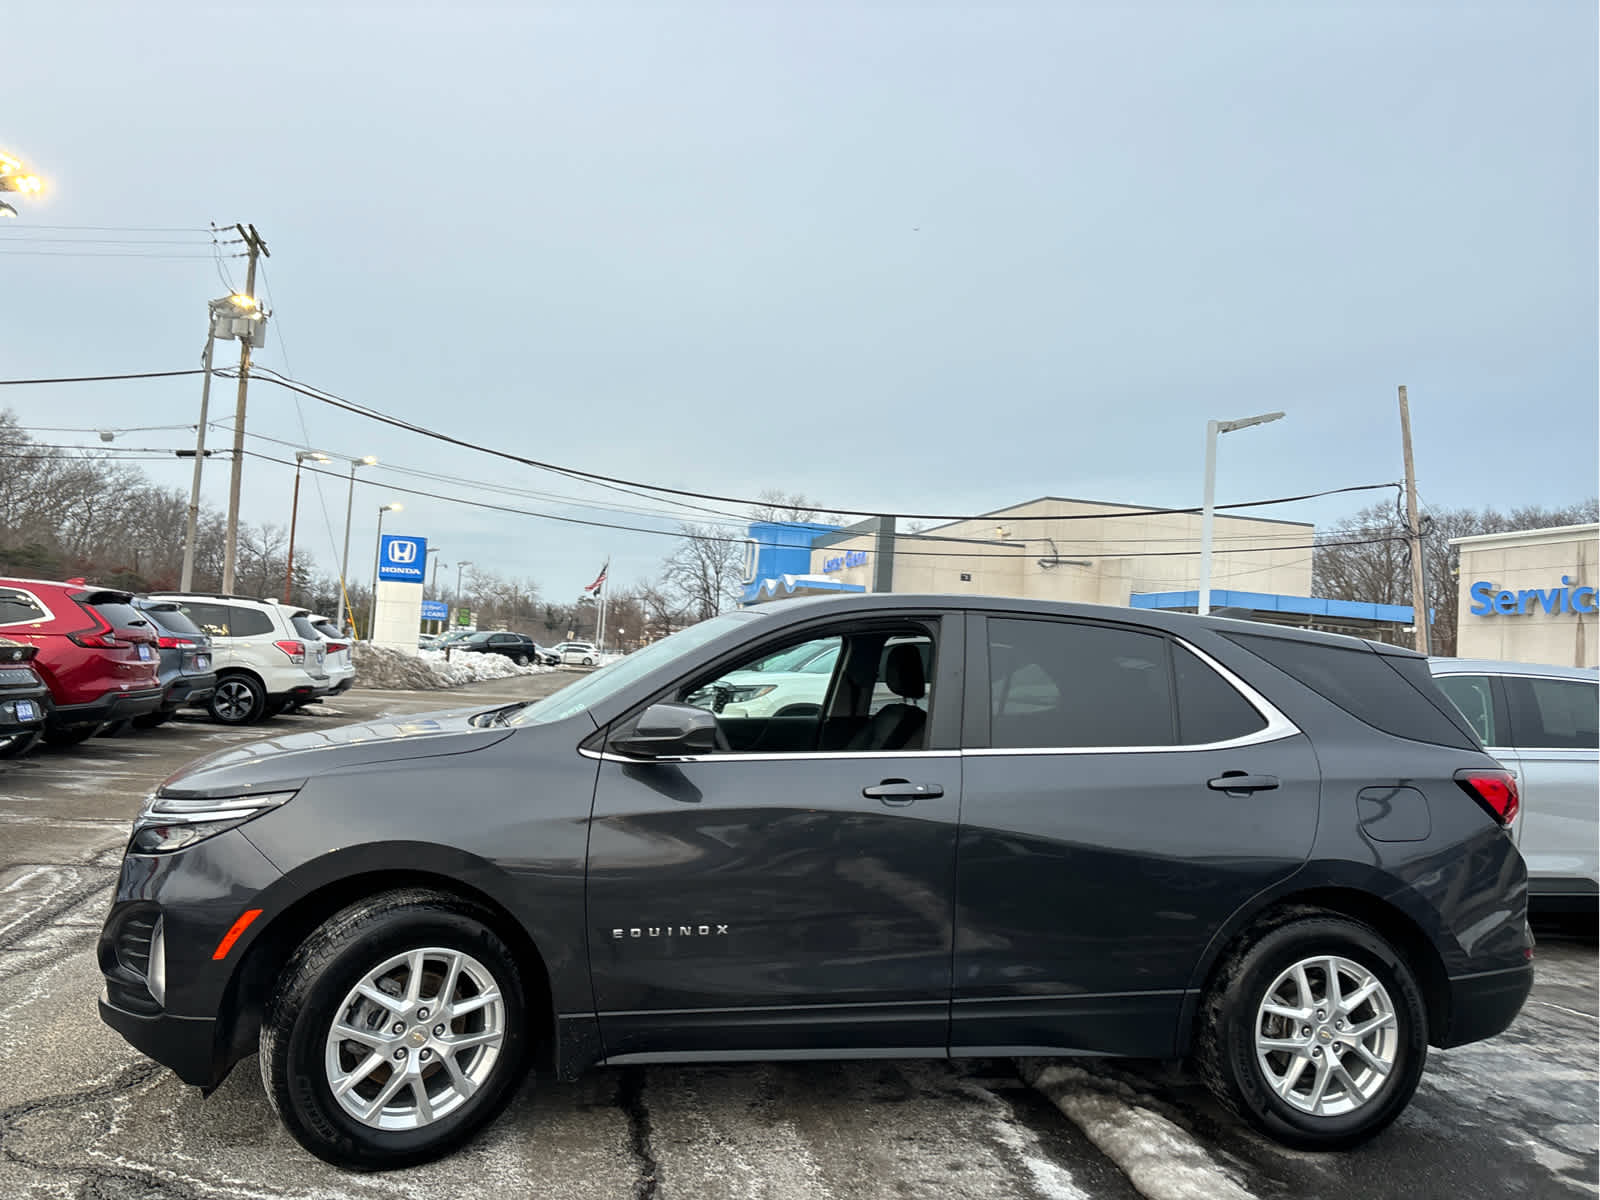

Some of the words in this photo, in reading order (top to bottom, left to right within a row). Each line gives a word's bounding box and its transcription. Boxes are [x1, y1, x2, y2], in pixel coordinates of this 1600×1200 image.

[381, 566, 421, 575] HONDA
[1470, 575, 1599, 616] Servic
[612, 925, 728, 938] EQUINOX
